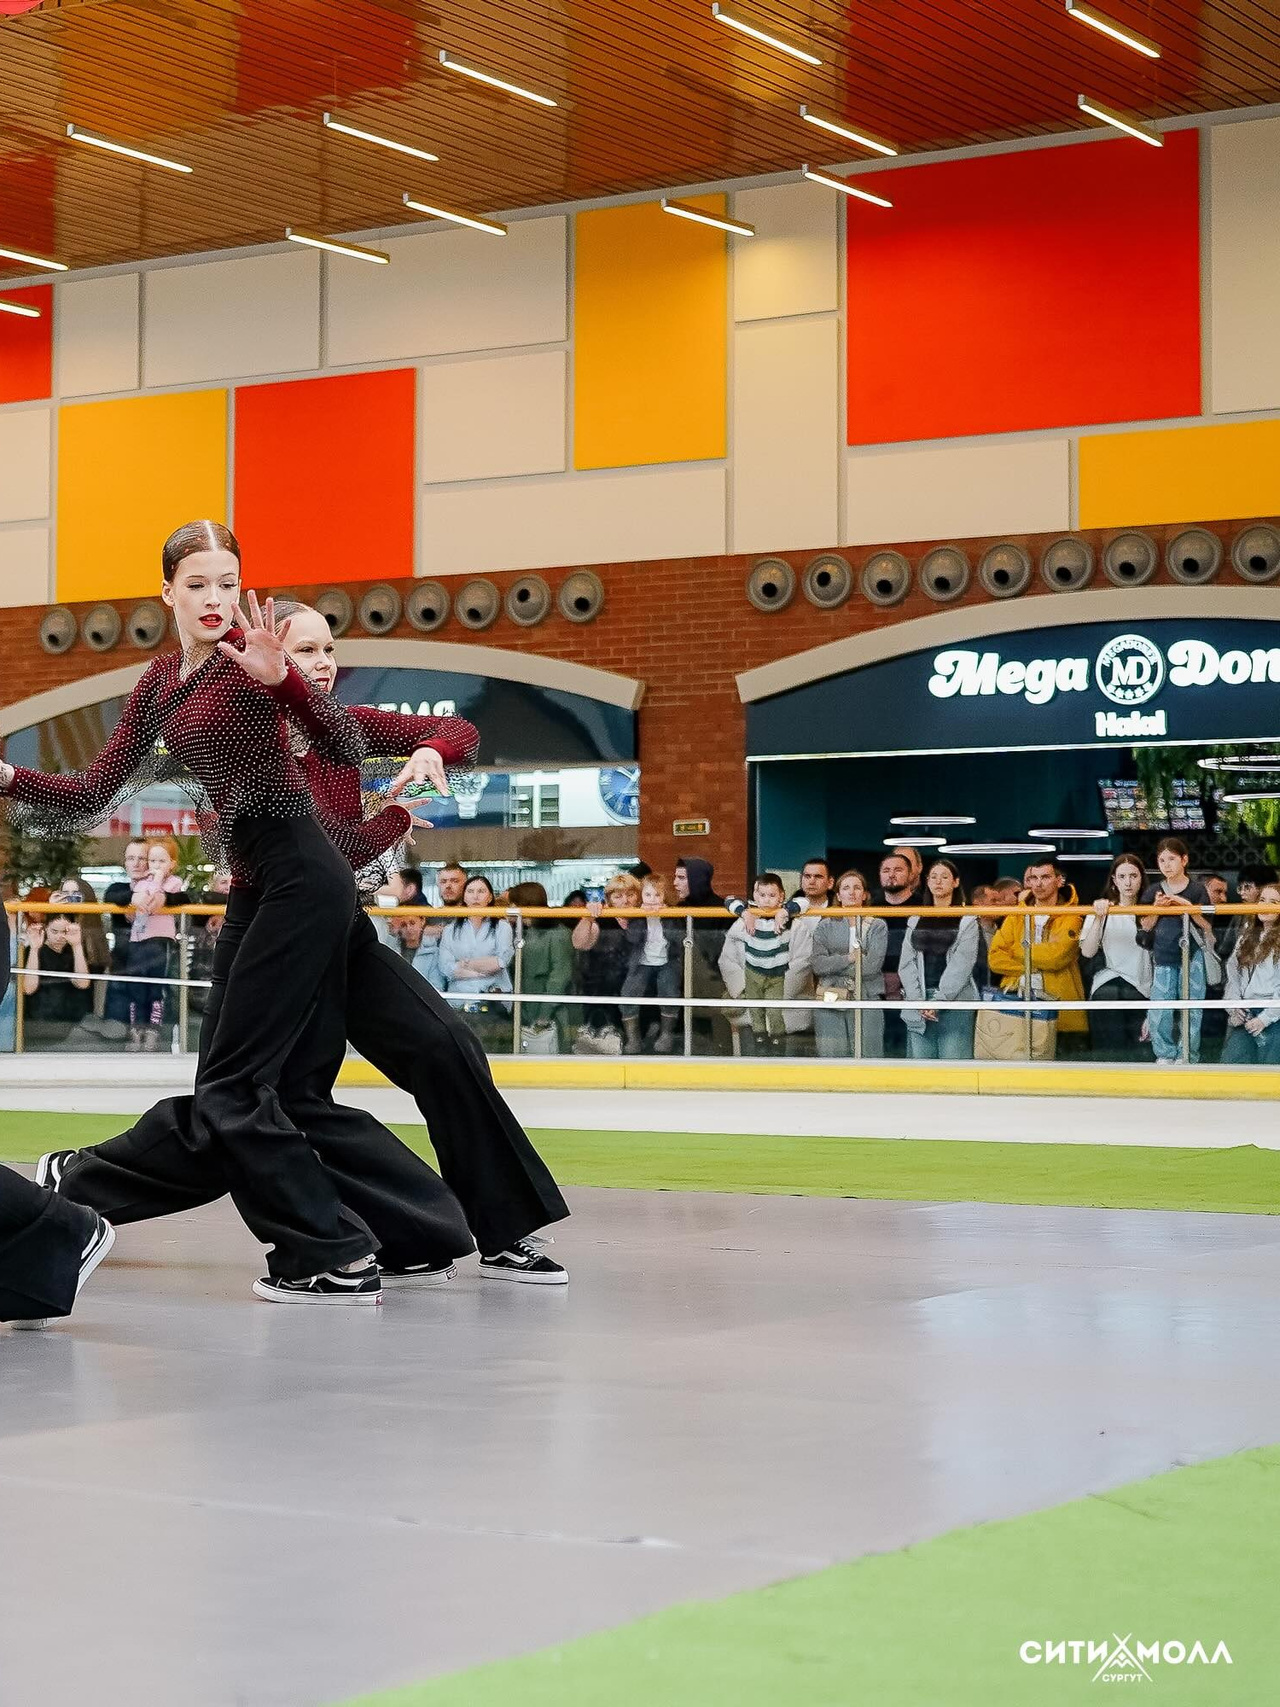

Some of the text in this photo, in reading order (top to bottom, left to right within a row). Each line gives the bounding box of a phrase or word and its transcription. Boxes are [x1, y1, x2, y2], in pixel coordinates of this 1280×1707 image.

[928, 650, 1089, 705] Mega
[1111, 655, 1151, 686] MD
[1095, 709, 1167, 737] Halal
